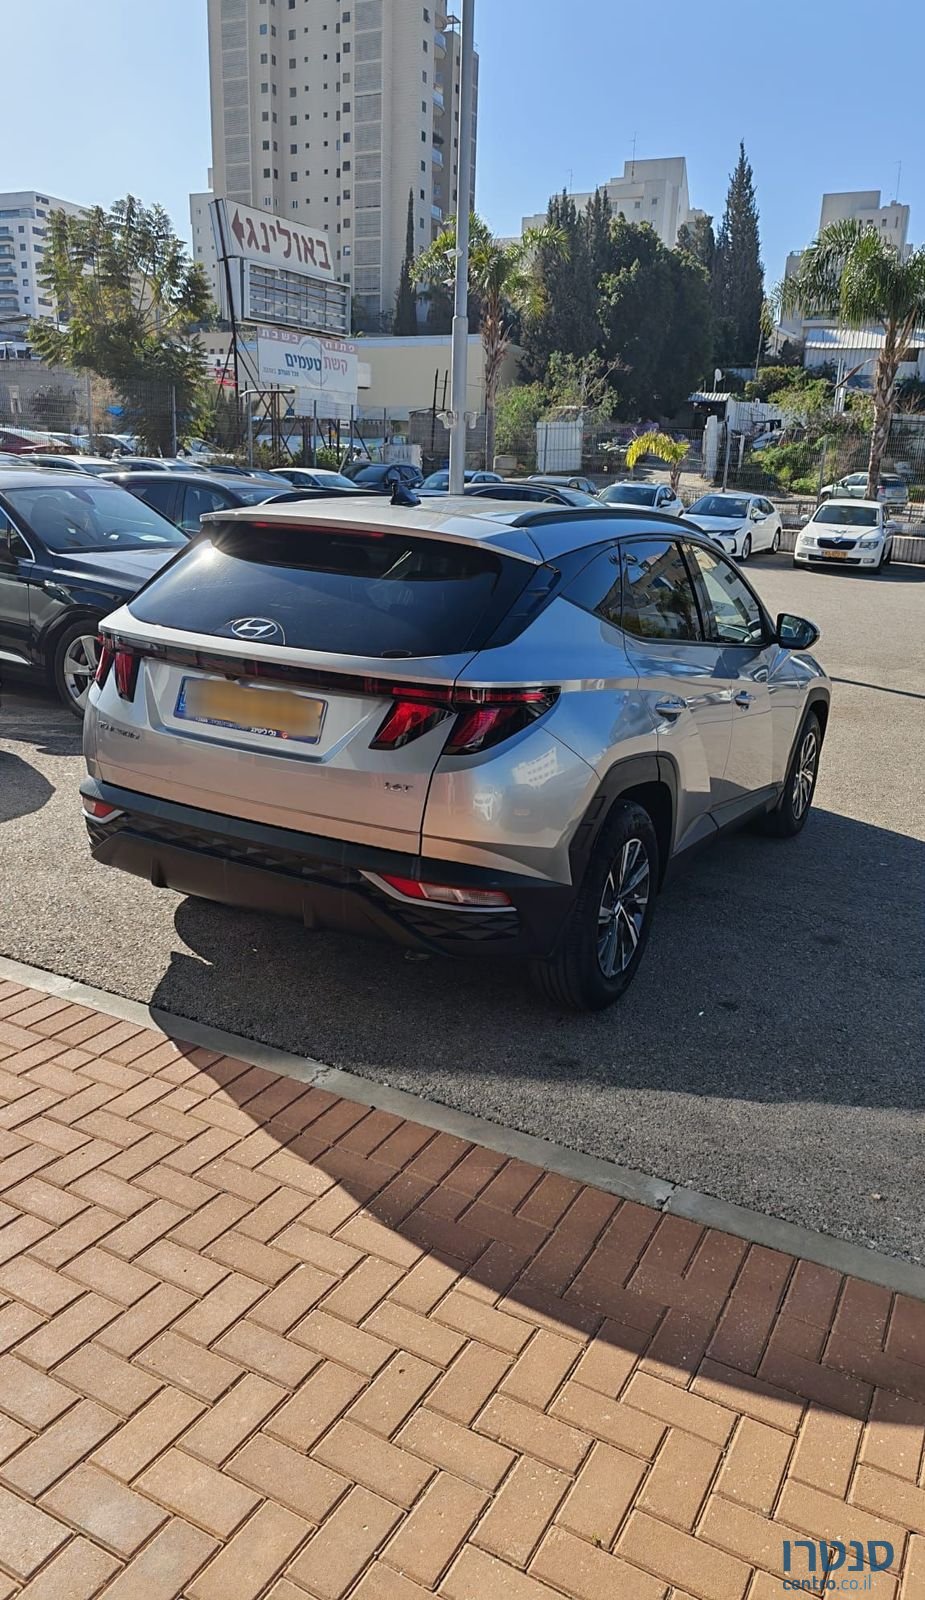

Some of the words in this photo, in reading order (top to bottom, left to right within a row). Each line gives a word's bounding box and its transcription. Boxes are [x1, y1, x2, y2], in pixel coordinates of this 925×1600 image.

[246, 218, 331, 270] באולינג
[262, 329, 299, 343] בשבת
[325, 341, 355, 352] פתוח
[285, 353, 322, 371] טעמים
[323, 356, 348, 376] קשת
